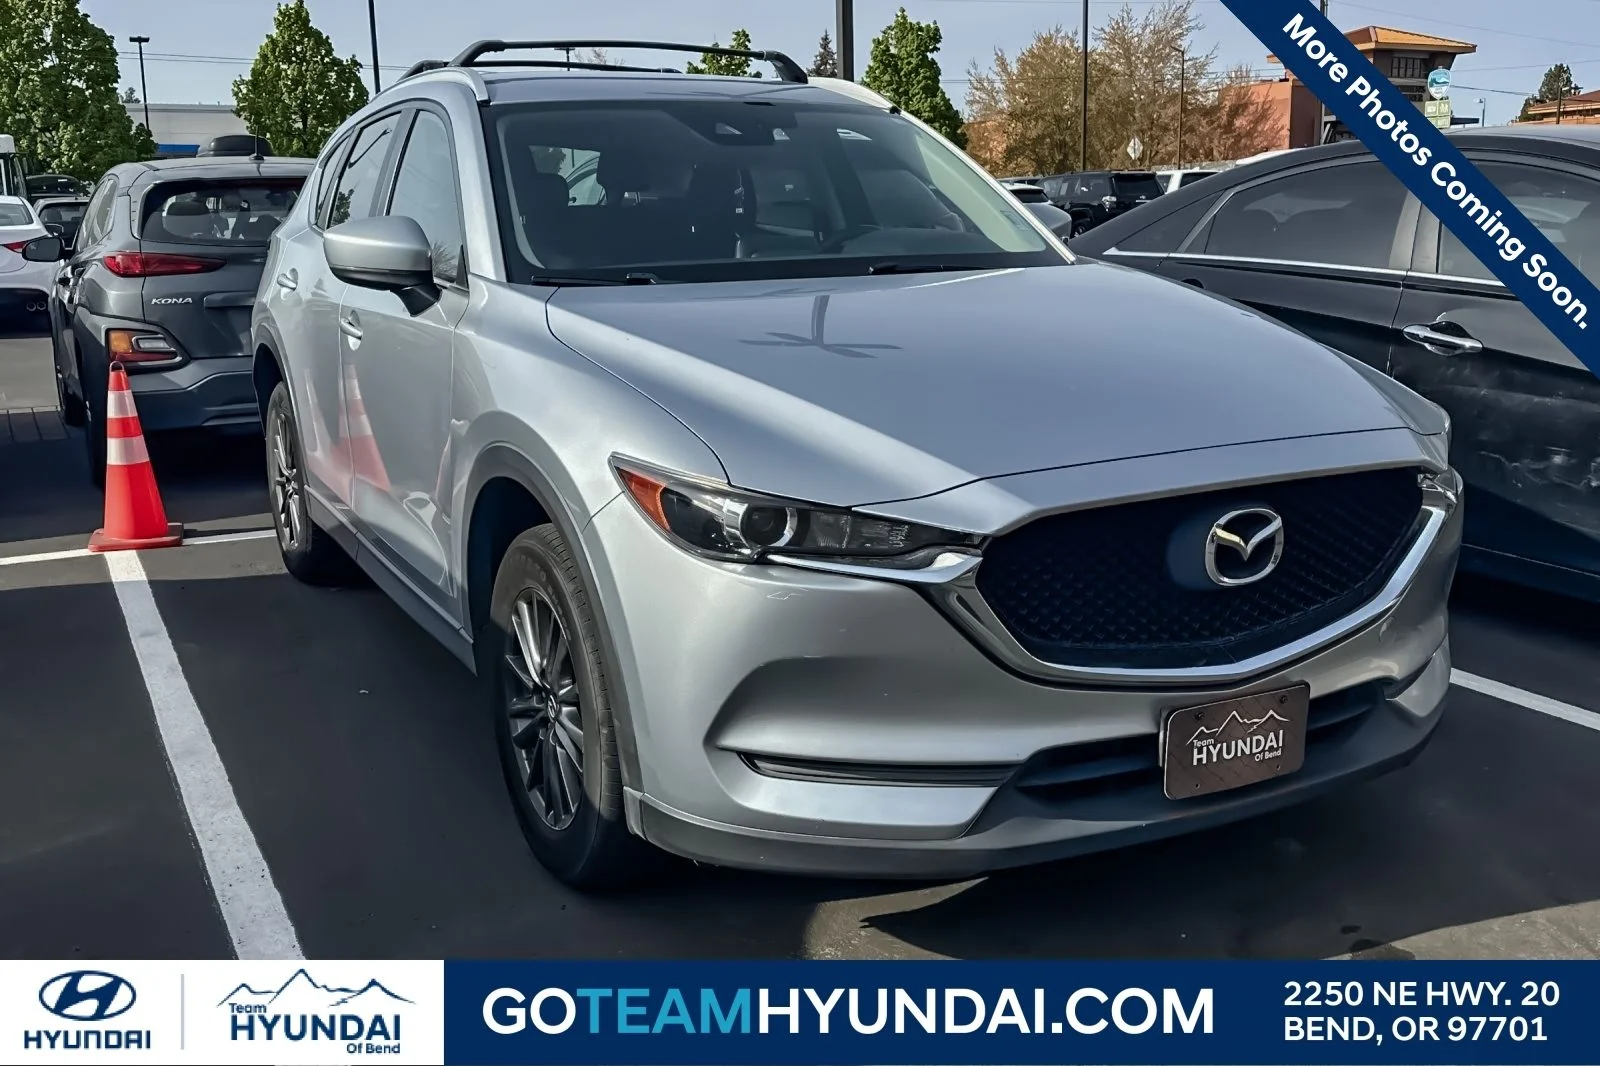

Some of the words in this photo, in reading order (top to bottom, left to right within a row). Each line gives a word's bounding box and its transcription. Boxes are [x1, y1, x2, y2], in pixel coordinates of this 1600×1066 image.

[151, 297, 193, 305] KONA
[1192, 730, 1284, 766] HYUNDAI
[1193, 738, 1215, 747] Team
[1254, 752, 1264, 762] Of
[1264, 748, 1282, 760] Bend
